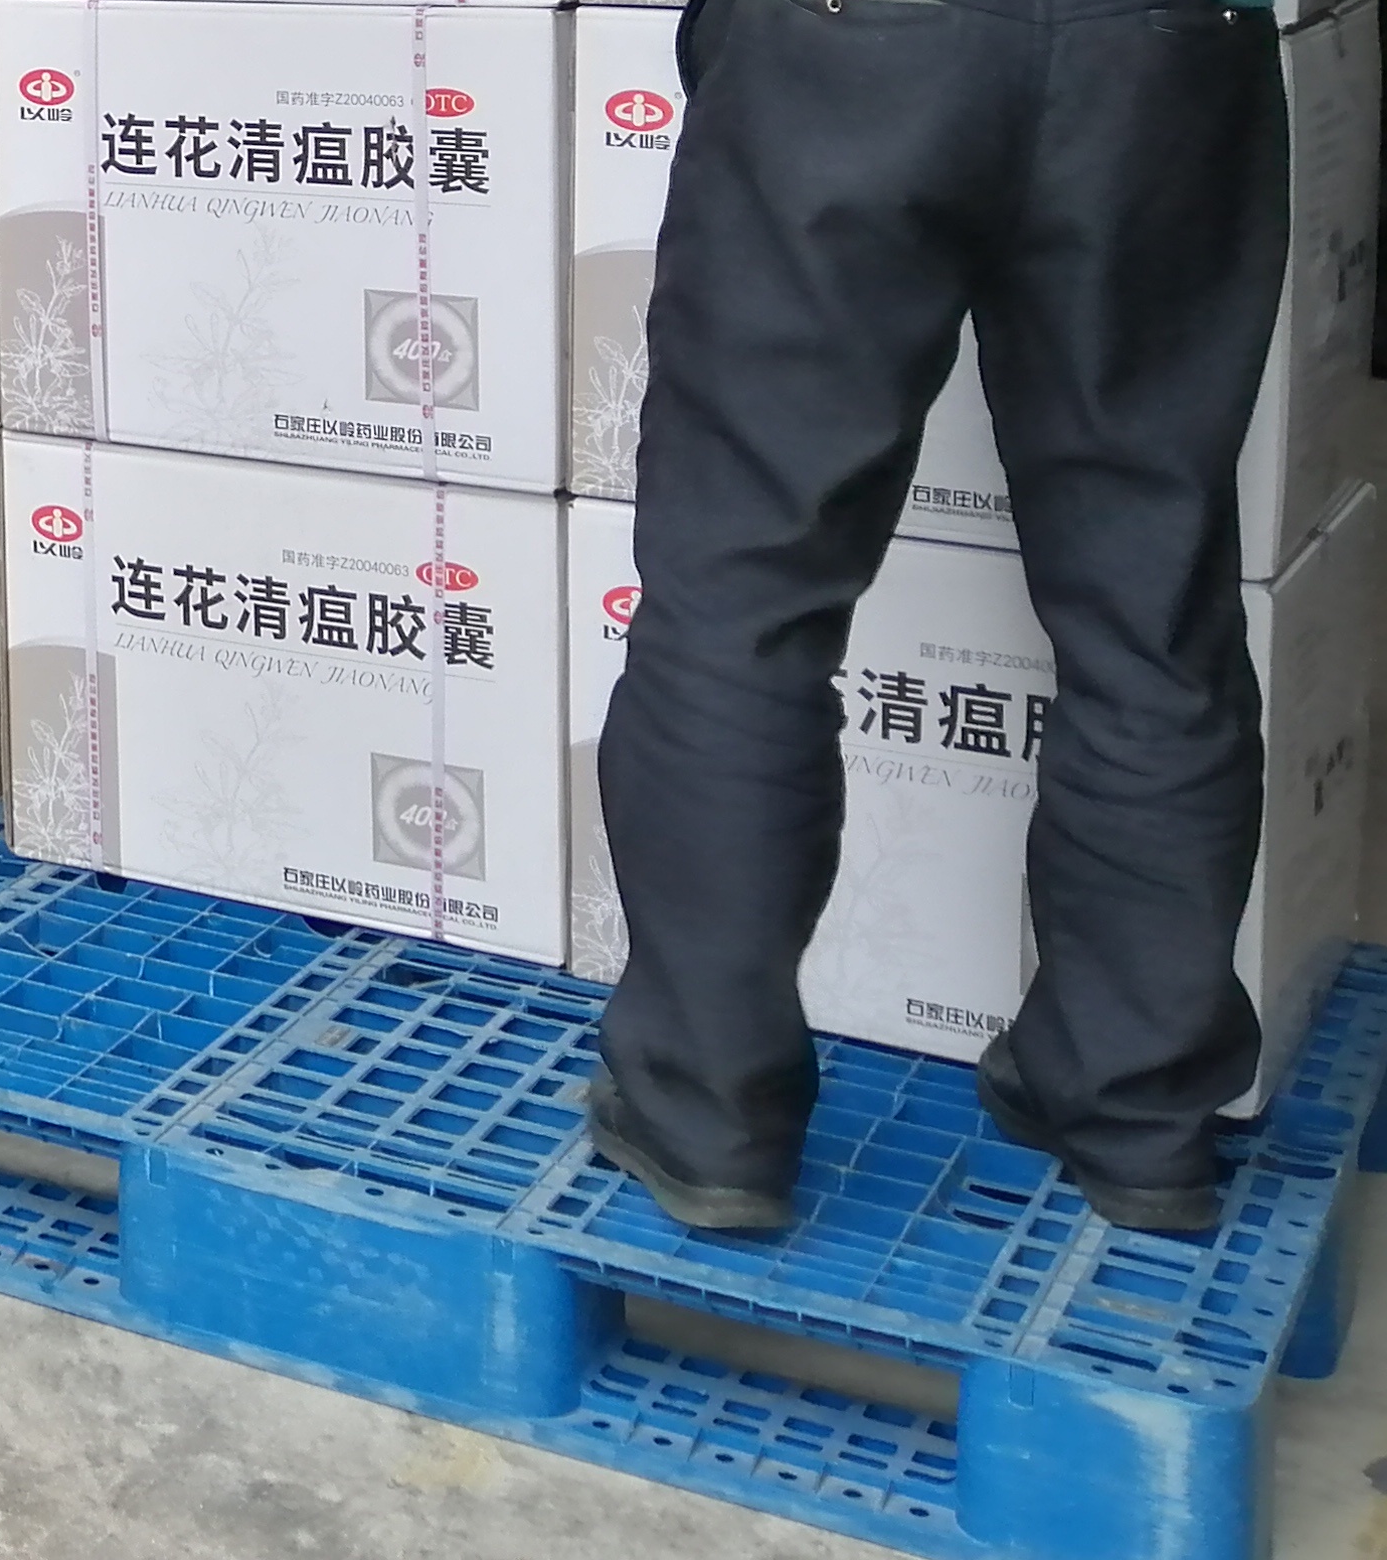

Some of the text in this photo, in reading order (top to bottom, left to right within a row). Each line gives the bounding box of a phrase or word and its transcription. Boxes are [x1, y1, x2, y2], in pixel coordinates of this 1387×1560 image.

[20, 106, 73, 122] 以岭
[275, 88, 405, 111] 国药准字Z20040063
[101, 113, 489, 194] 连花清瘟胶囊
[605, 132, 670, 150] 以岭
[103, 190, 198, 213] LIANHUA
[205, 196, 313, 227] QINGWEN
[273, 414, 492, 452] 石家庄以岭药业股份限公司
[31, 541, 83, 562] 以岭
[280, 547, 409, 581] 国药准字Z20040063
[111, 556, 494, 669] 连花清瘟胶囊
[113, 631, 206, 662] LIANHUA
[213, 646, 320, 687] QINGWEN
[844, 753, 959, 786] INGWEN
[400, 801, 458, 835] 40盒
[282, 866, 498, 924] 石家庄以岭药业股份限公司
